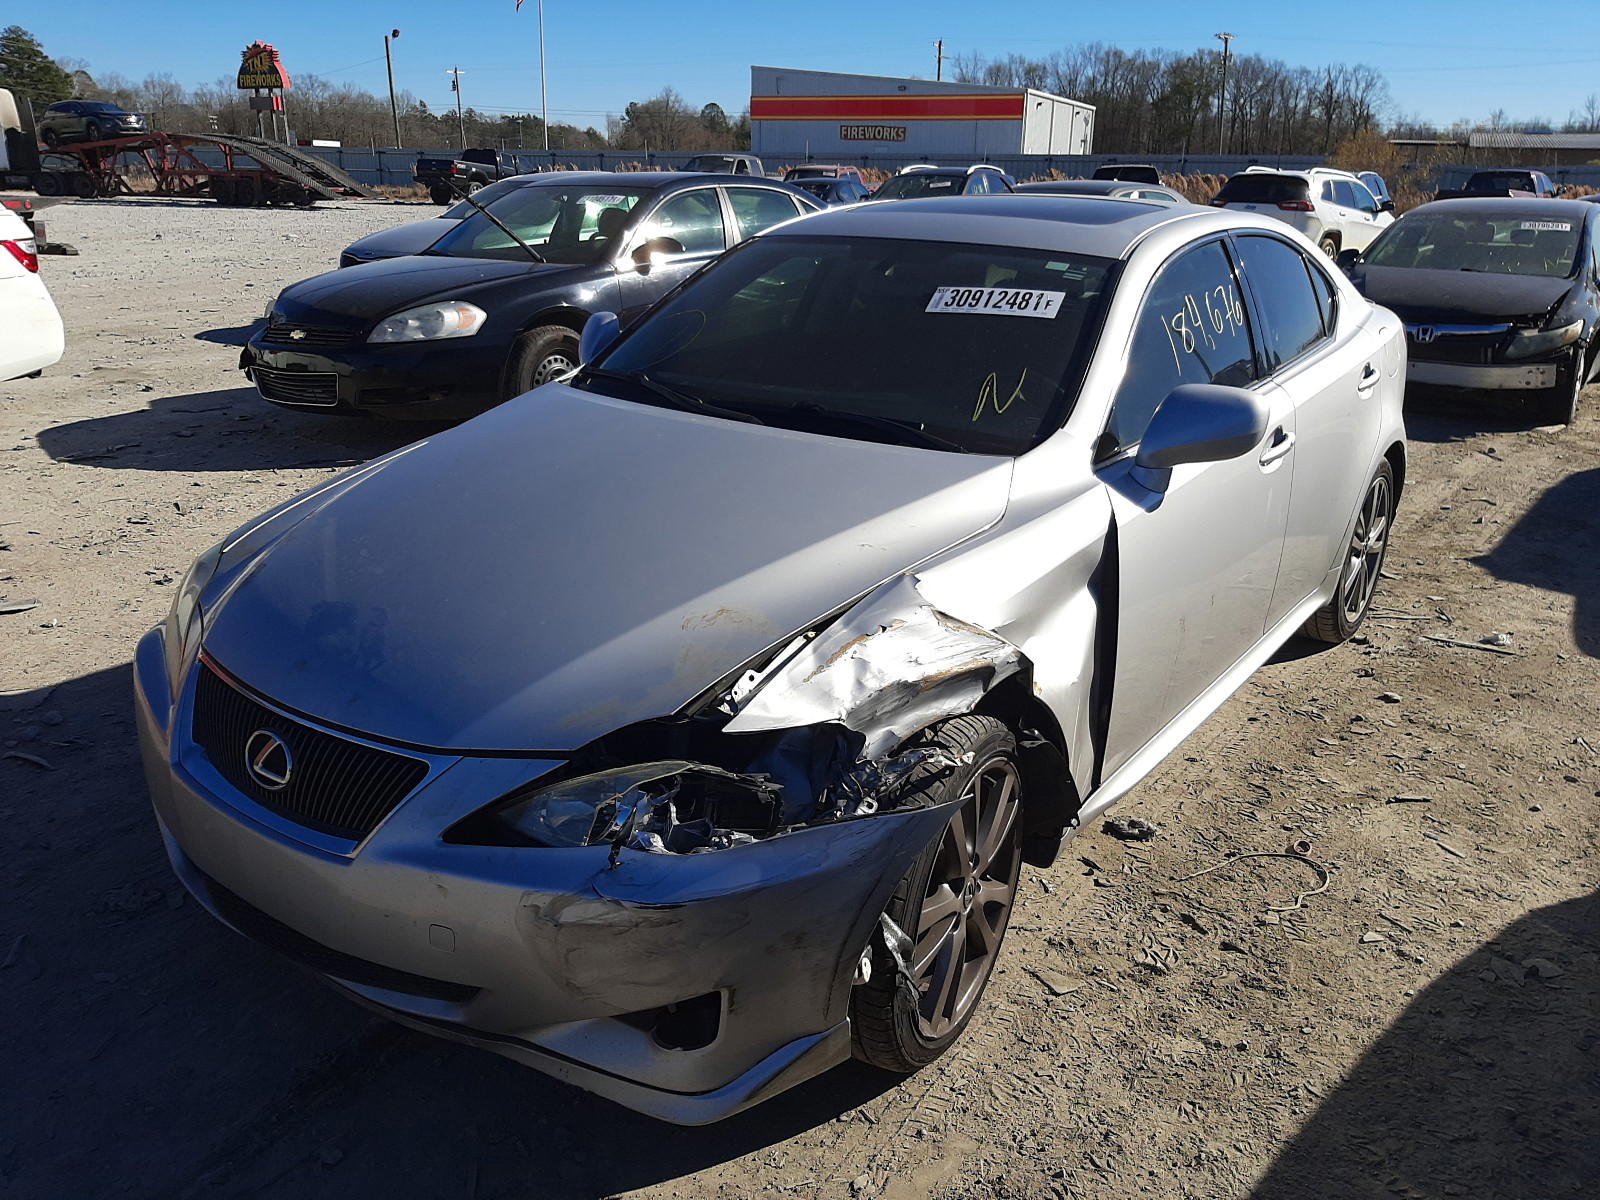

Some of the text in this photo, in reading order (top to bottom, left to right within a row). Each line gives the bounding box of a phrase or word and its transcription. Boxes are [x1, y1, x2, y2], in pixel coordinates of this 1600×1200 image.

[247, 52, 268, 73] TNT
[239, 74, 281, 87] FIREWORKS
[841, 126, 905, 141] FIREWORKS
[943, 288, 1044, 311] 30912481
[1044, 299, 1054, 311] F
[1161, 284, 1243, 376] 184,676
